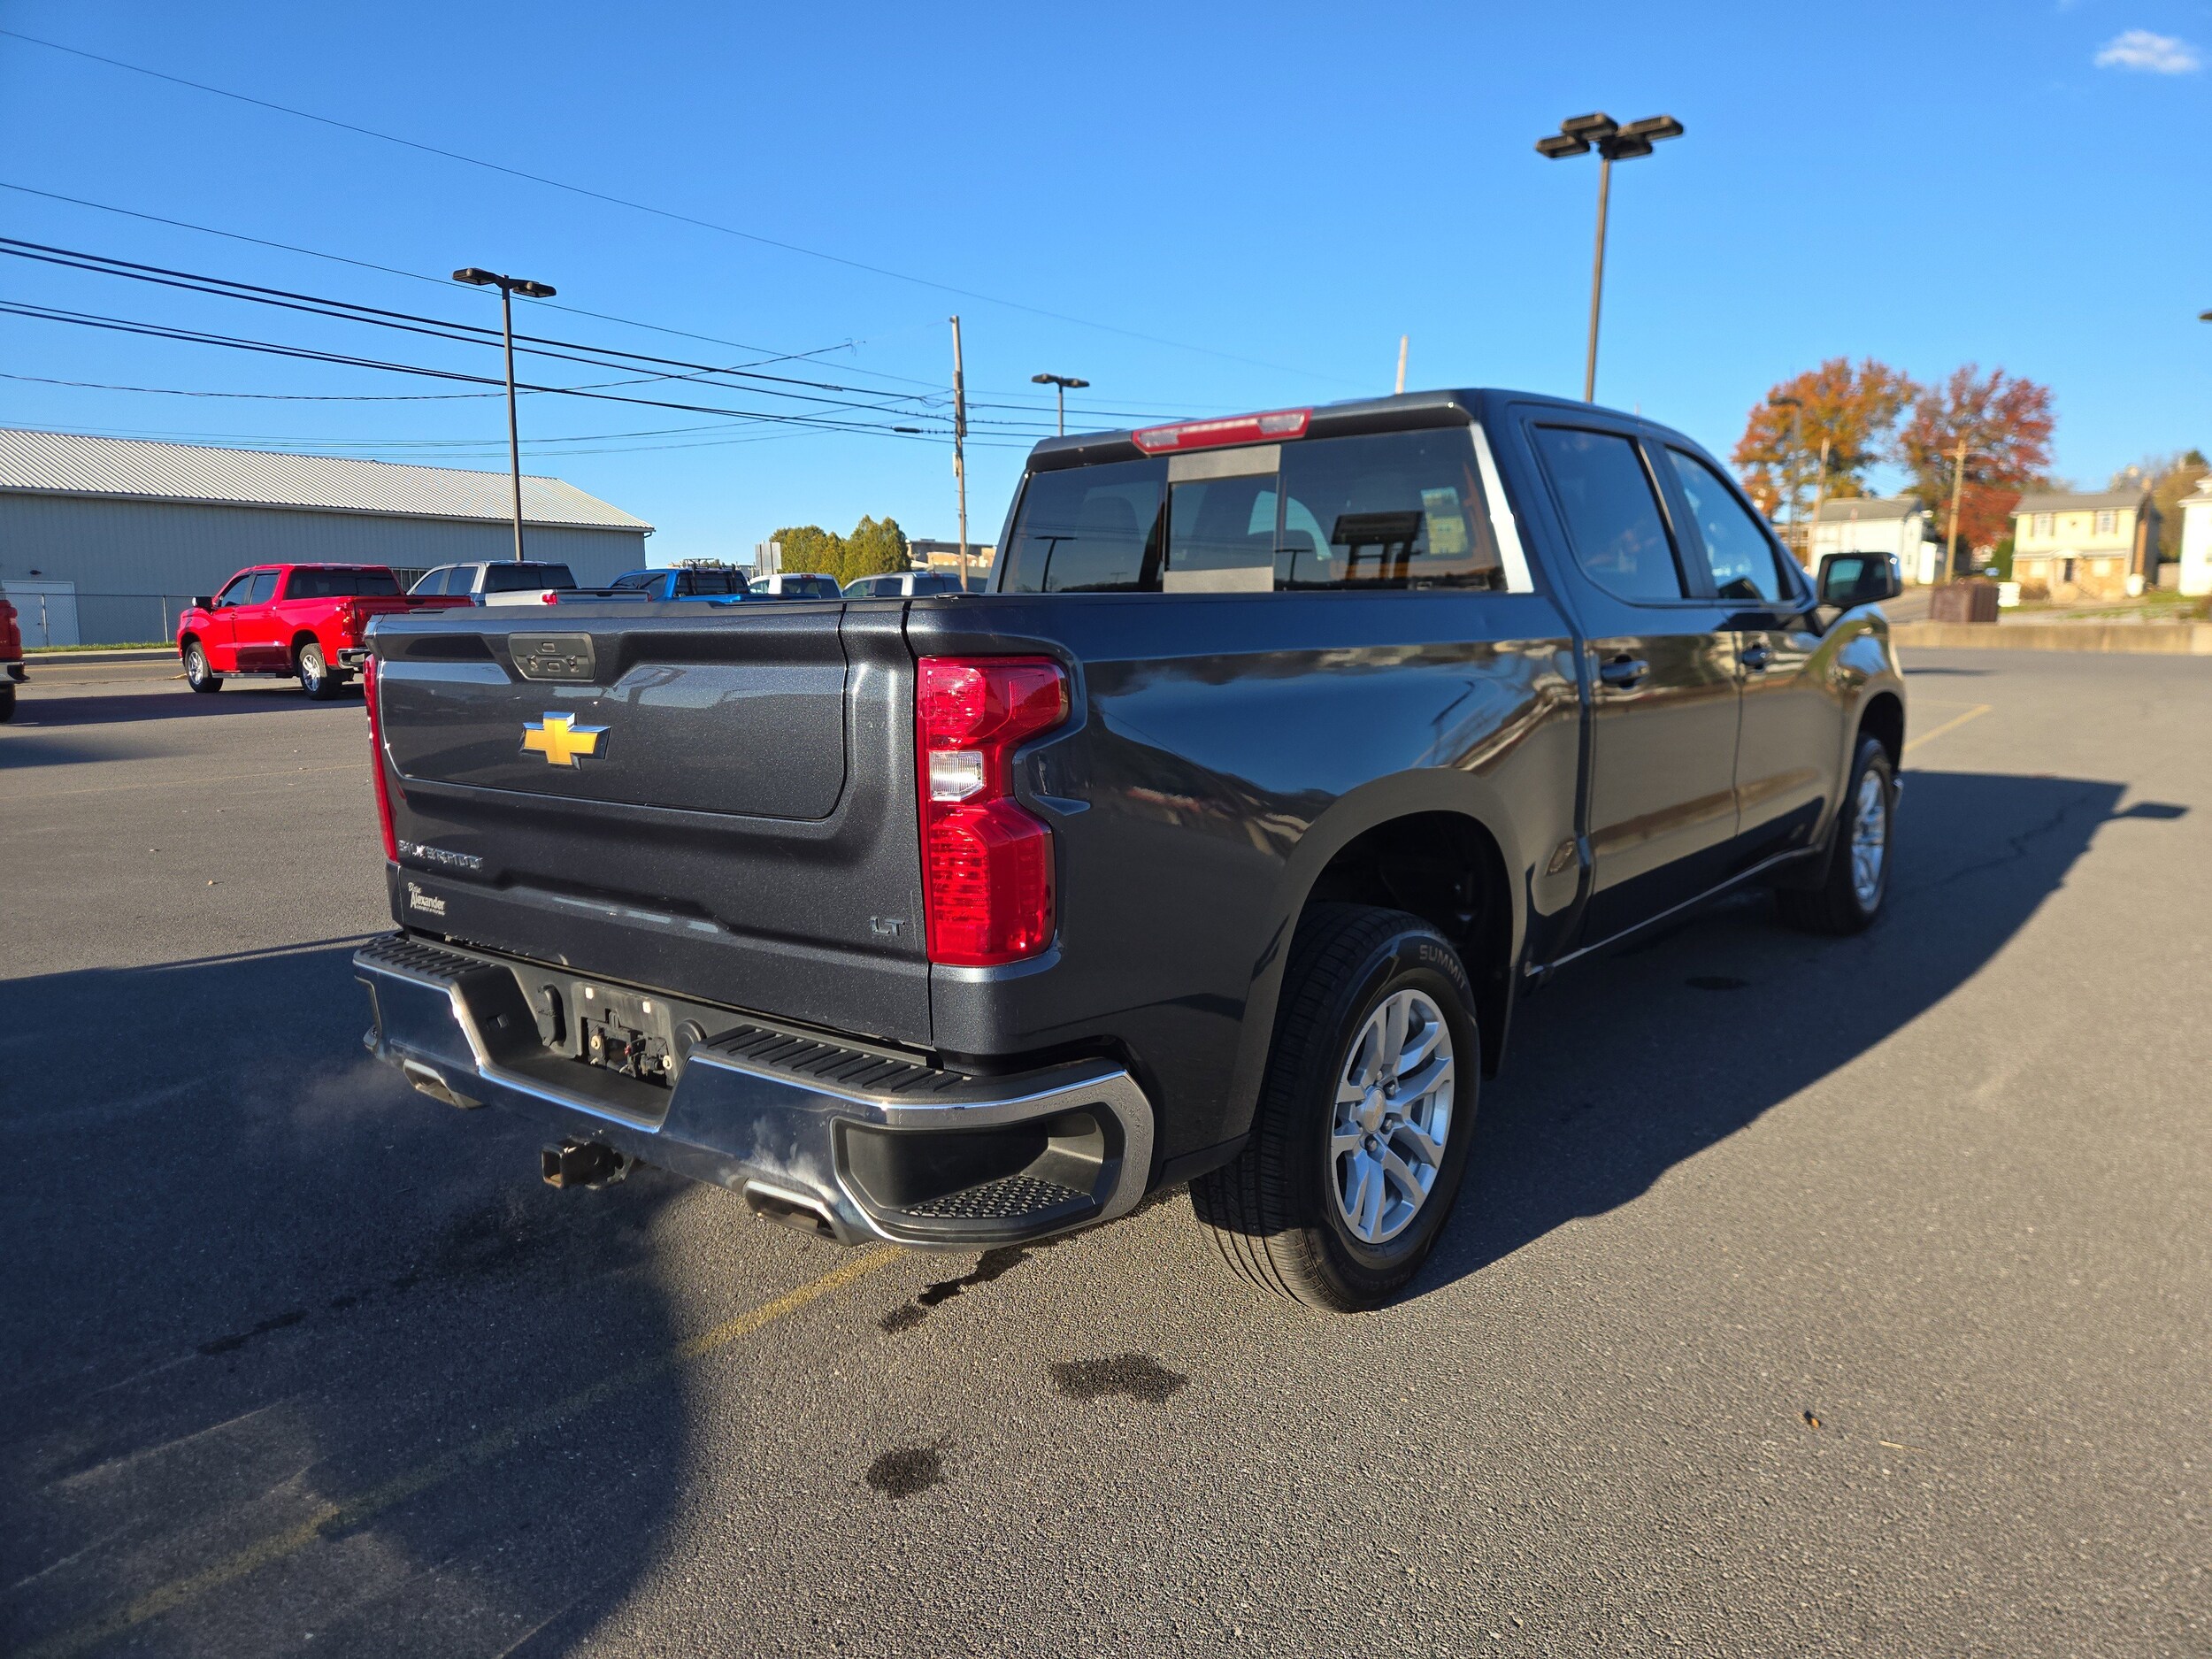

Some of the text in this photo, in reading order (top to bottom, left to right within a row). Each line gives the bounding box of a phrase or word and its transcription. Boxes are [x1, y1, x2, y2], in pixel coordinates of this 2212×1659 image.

[410, 891, 445, 911] Alexander
[869, 915, 906, 936] LT
[1419, 944, 1466, 989] SUMMIT
